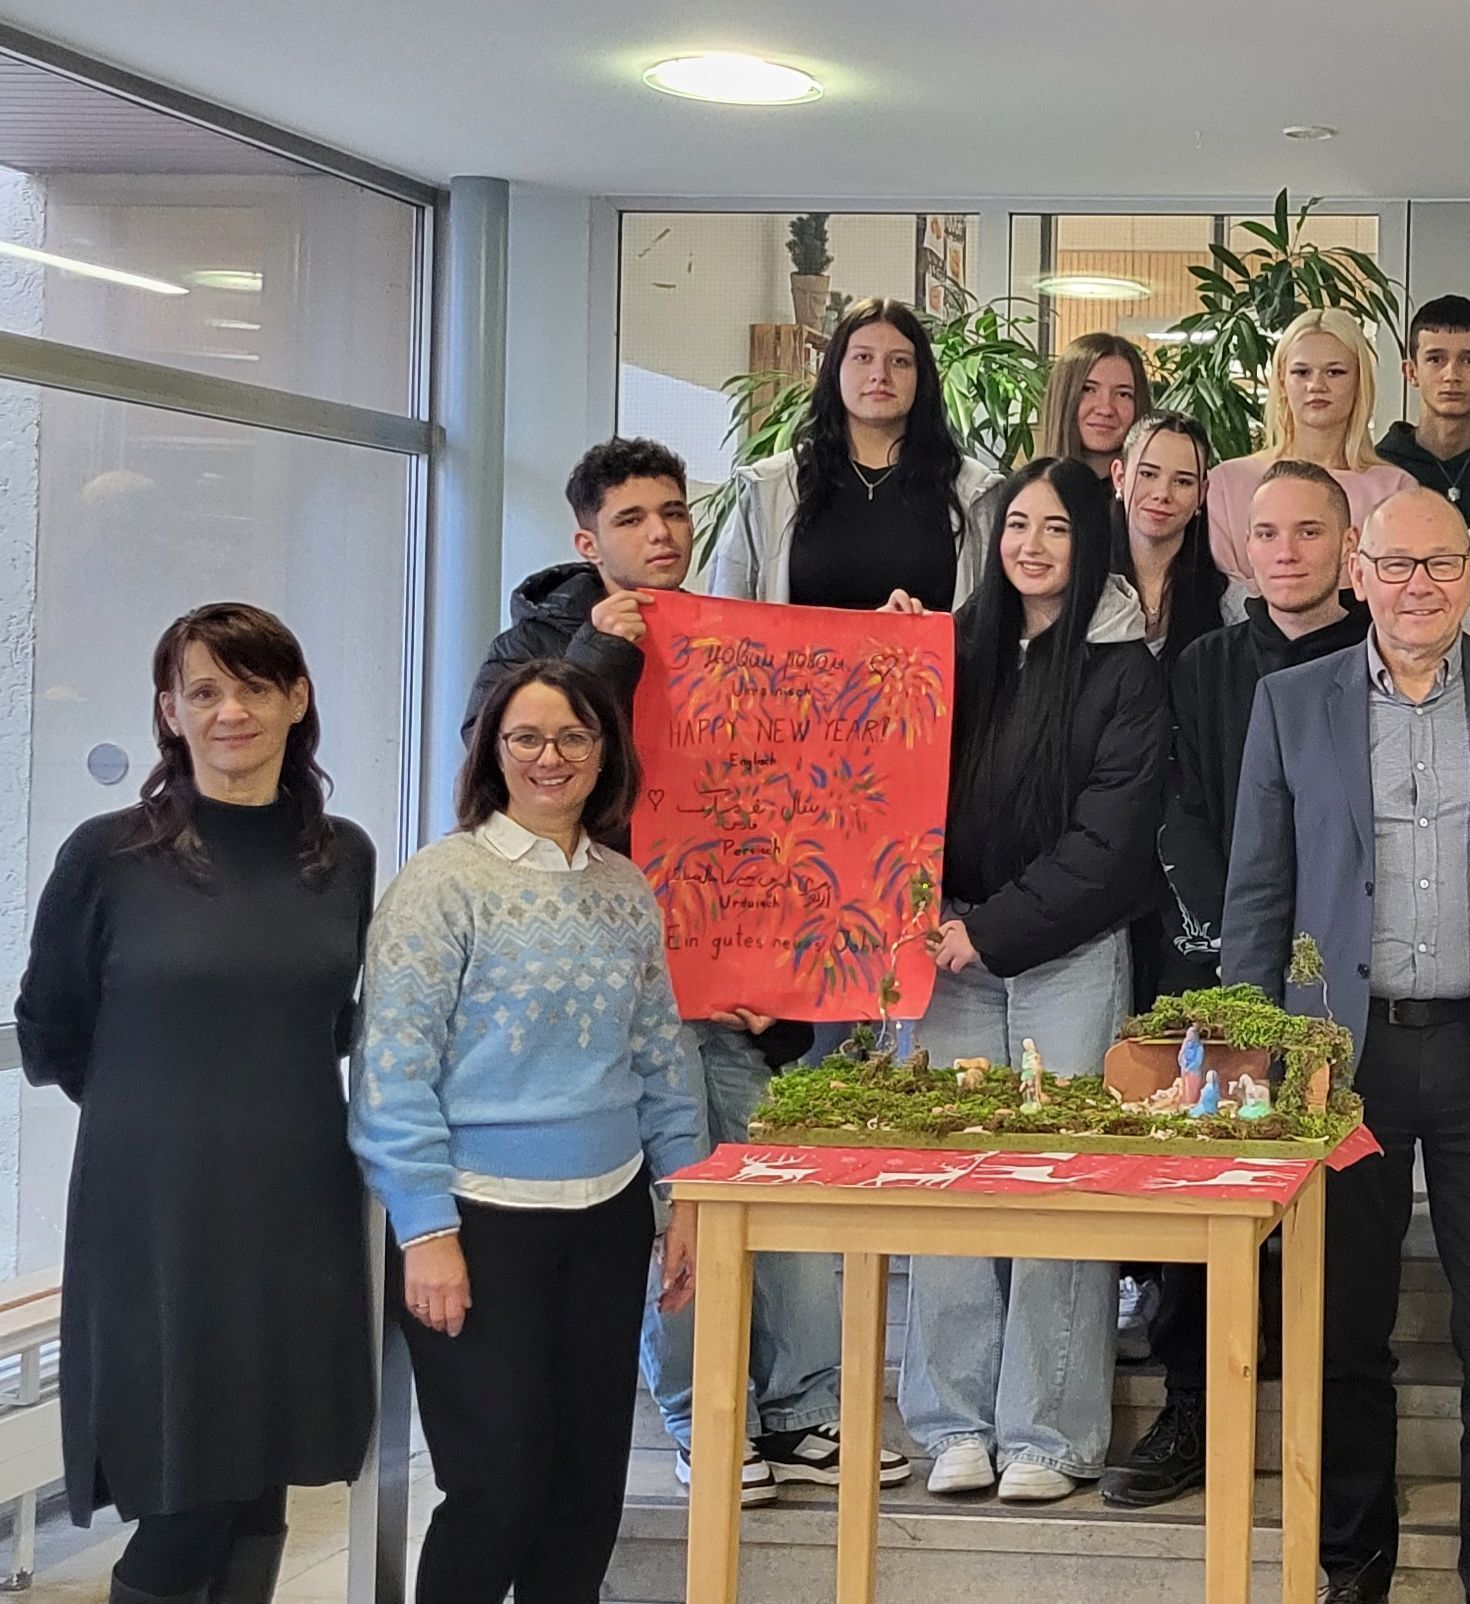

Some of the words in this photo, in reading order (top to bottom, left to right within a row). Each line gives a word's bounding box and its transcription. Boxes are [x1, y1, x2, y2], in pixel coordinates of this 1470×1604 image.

[669, 718, 737, 749] HAPPY
[755, 717, 811, 744] NEW
[824, 716, 891, 744] YEAR!
[667, 925, 699, 951] Ein
[711, 922, 764, 961] gutes
